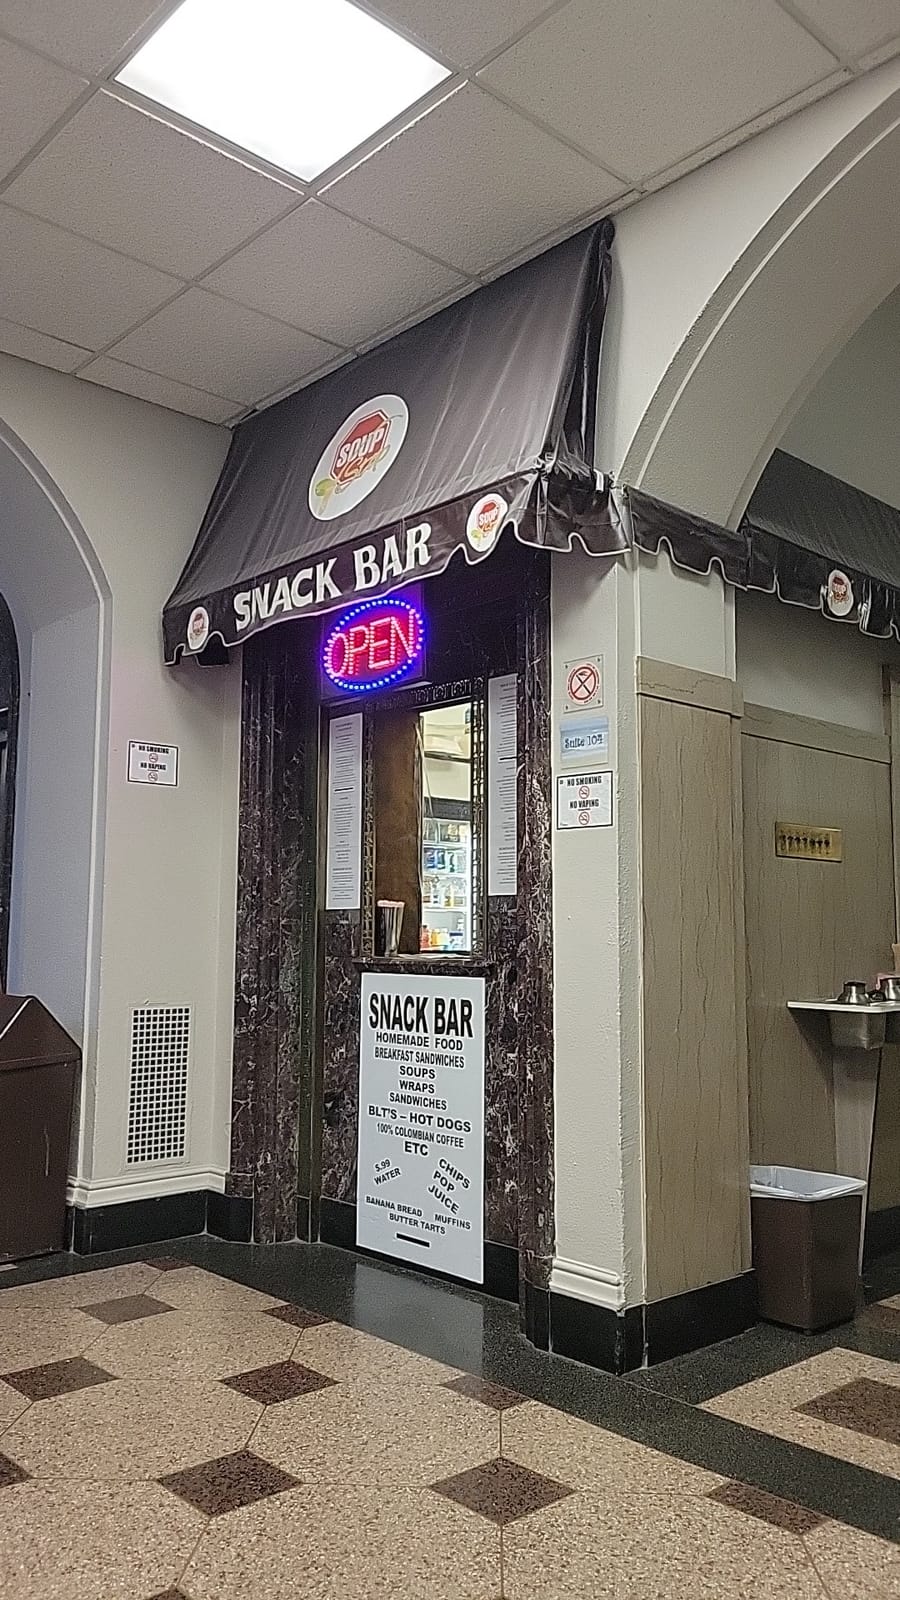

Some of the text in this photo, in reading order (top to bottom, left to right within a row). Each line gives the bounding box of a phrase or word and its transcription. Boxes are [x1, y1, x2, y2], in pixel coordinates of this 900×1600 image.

[337, 427, 385, 468] SOUP
[233, 522, 432, 633] SNACK BAR
[325, 608, 418, 679] OPEN
[565, 737, 585, 749] Suite
[567, 778, 575, 787] NO
[576, 776, 602, 786] SMOKING
[570, 799, 599, 809] NO VAPING
[369, 993, 473, 1038] SNACK BAR
[376, 1032, 463, 1051] HOMEMADE FOOD
[374, 1047, 465, 1069] BREAKFAST SANDWICHES
[399, 1065, 436, 1080] SOUPS
[399, 1080, 435, 1094] WRAPS
[389, 1092, 447, 1111] SANDWICHES
[368, 1105, 397, 1120] BLT'S
[409, 1112, 433, 1126] HOT
[437, 1117, 471, 1132] DOGS
[377, 1123, 464, 1148] 100% COLOMBIAN COFFEE
[404, 1141, 428, 1156] ETC
[374, 1167, 401, 1185] WATER
[433, 1170, 455, 1192] POP
[439, 1158, 471, 1189] CHIPS
[366, 1196, 423, 1217] BANANA BREAD
[428, 1185, 459, 1215] JUICE
[389, 1212, 446, 1235] BUTTER TARTS
[434, 1213, 471, 1230] MUFFINS
